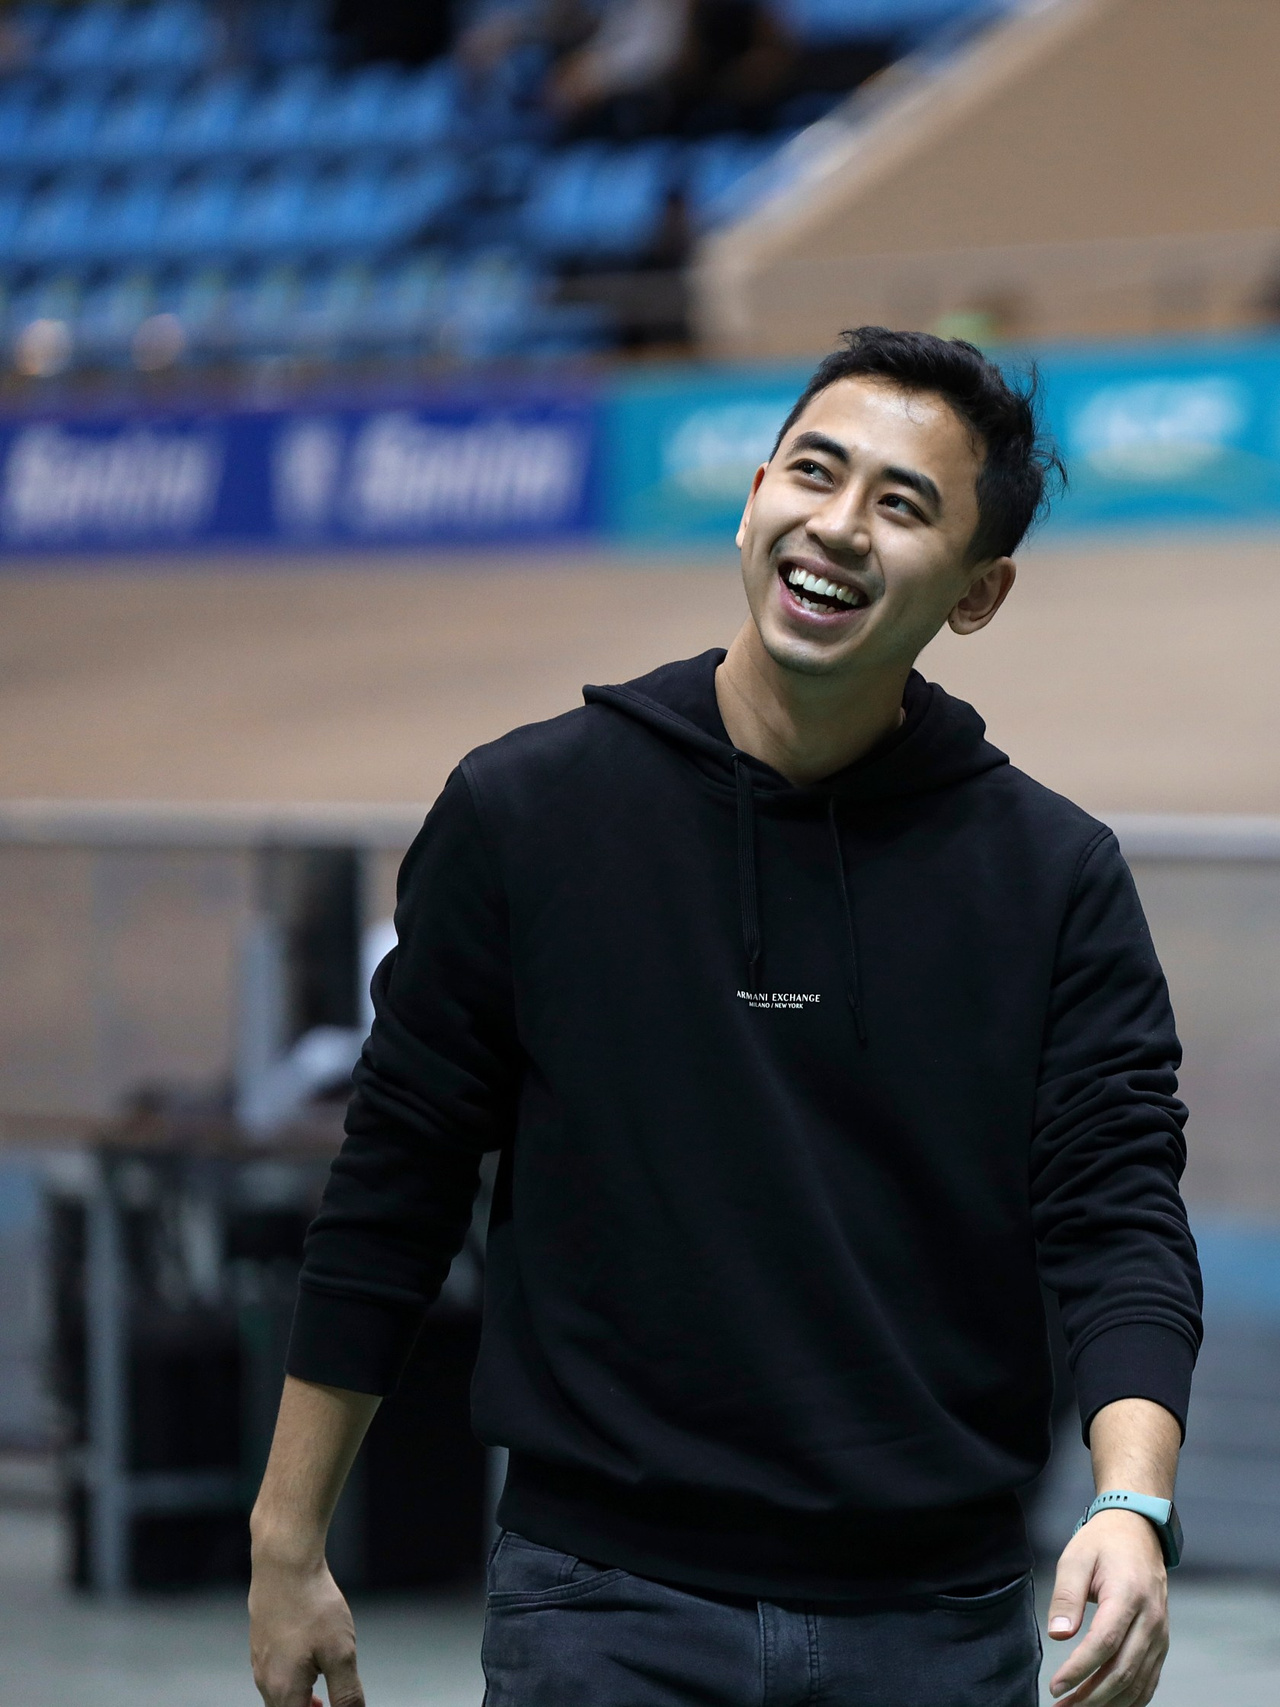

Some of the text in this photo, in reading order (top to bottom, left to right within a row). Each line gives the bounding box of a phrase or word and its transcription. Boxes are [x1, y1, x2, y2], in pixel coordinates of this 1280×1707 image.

[736, 990, 821, 1003] ARMANI EXCHANGE
[749, 1001, 770, 1009] MILANO
